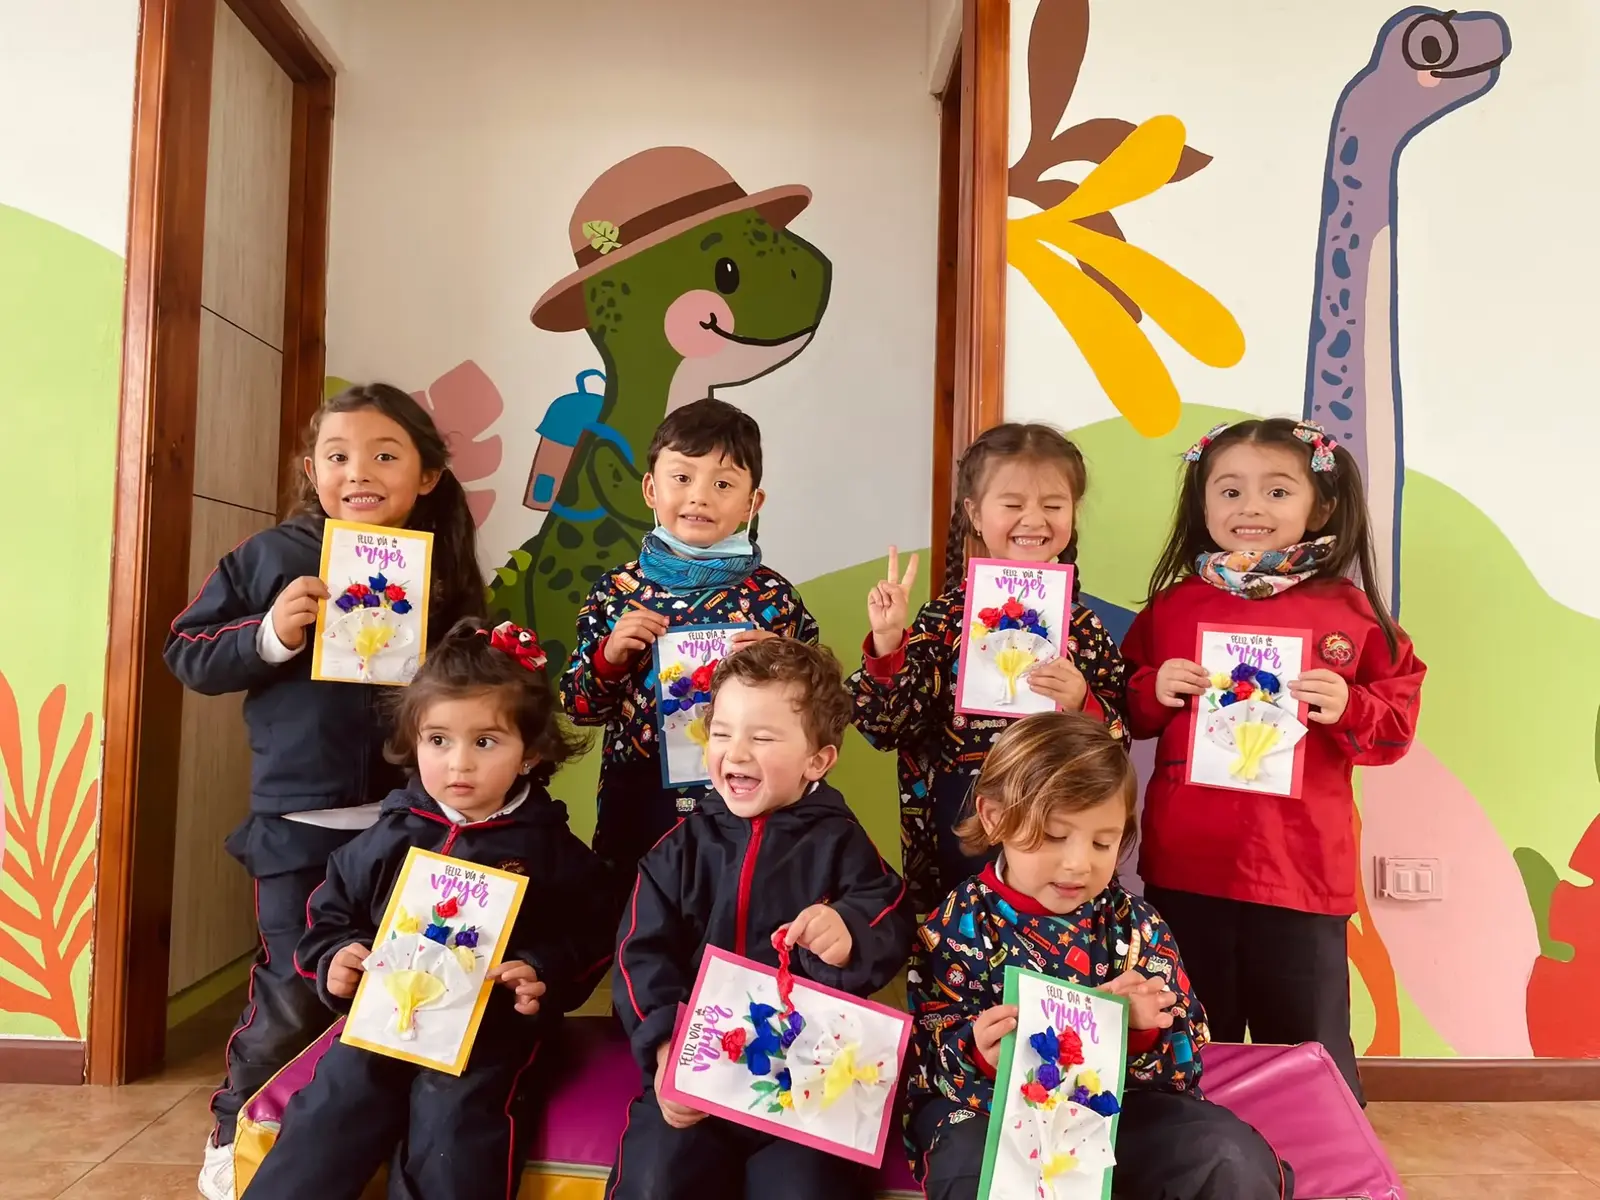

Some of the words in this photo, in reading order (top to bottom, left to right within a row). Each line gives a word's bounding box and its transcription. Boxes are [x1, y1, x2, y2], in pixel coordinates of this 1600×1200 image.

[357, 534, 374, 545] FELIZ
[1003, 568, 1018, 577] FELIZ
[688, 632, 704, 640] FELIZ
[1231, 635, 1248, 644] FELIZ
[445, 865, 462, 876] FELIZ
[1046, 985, 1063, 1000] FELIZ
[679, 1043, 698, 1066] FELIZ
